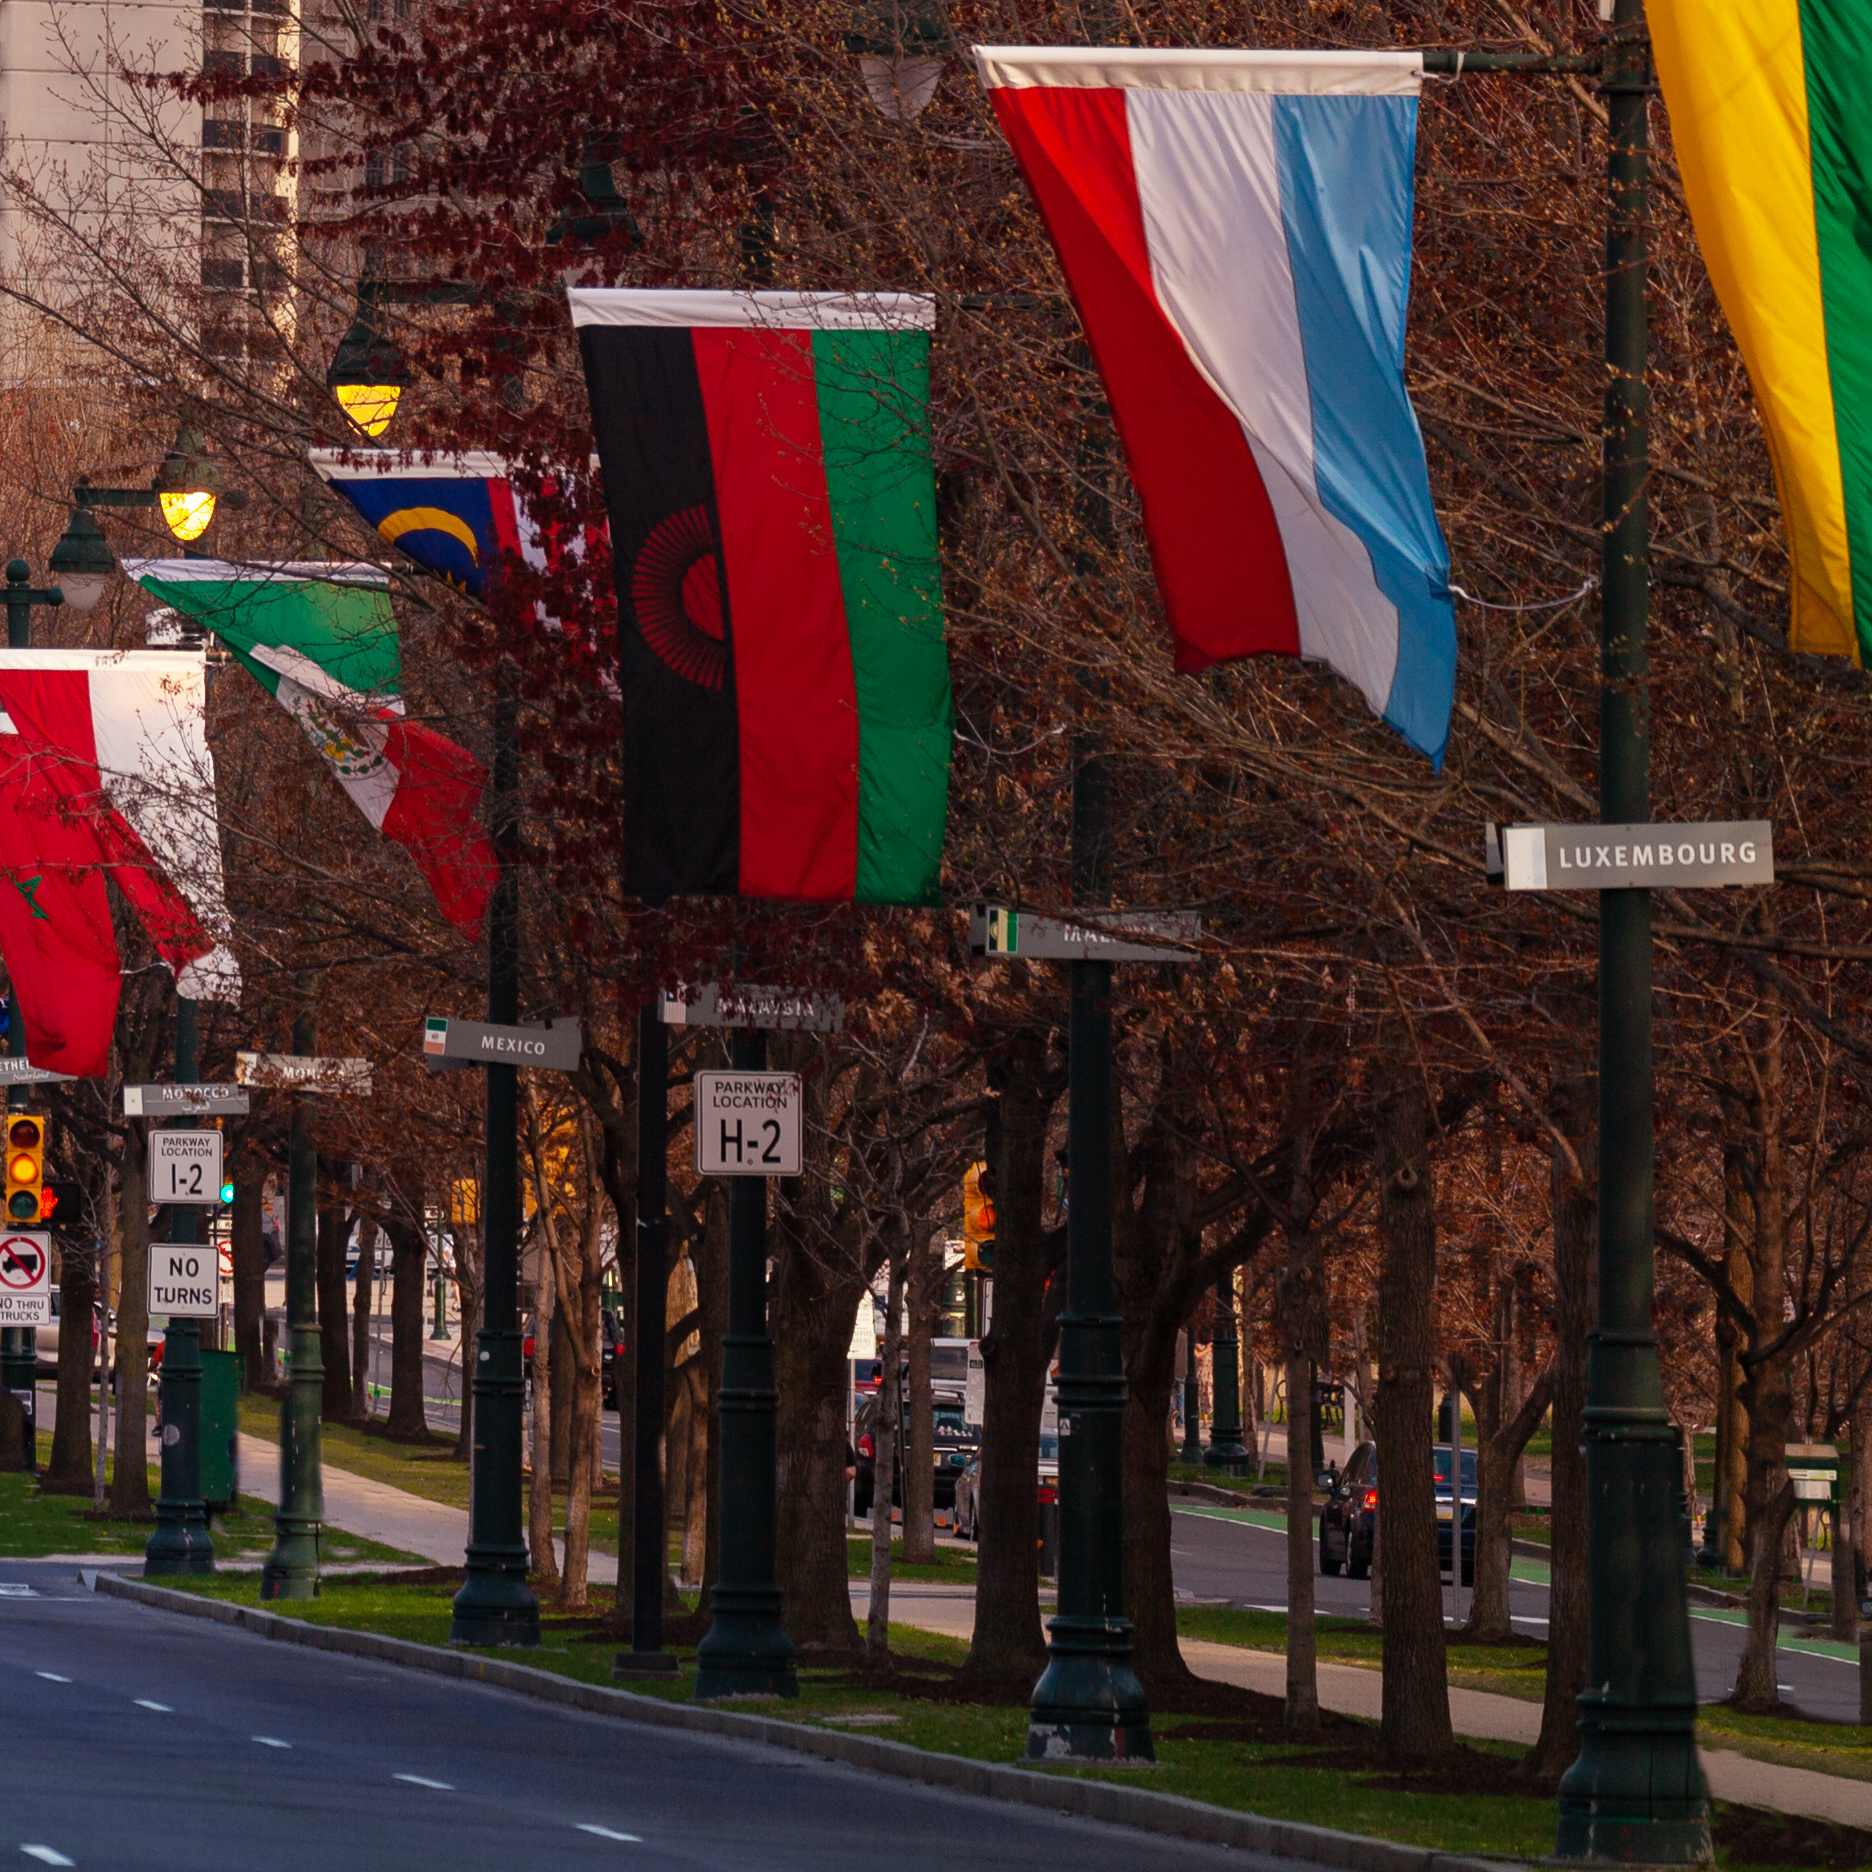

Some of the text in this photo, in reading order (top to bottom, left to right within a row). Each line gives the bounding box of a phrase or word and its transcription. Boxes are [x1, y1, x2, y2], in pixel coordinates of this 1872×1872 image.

[1559, 841, 1757, 869] LUXEMBOURG
[481, 1035, 546, 1056] MEXICO
[162, 1086, 230, 1099] MOROCCO
[714, 1081, 785, 1094] PARKWAY
[713, 1095, 788, 1109] LOCATION
[162, 1137, 211, 1147] PARKWAY
[720, 1118, 781, 1164] H-2
[161, 1147, 213, 1157] LOCATION
[170, 1163, 203, 1195] I-2
[169, 1257, 199, 1277] NO
[154, 1286, 212, 1305] TURNS
[16, 1300, 44, 1310] THRU
[0, 1311, 40, 1321] TRUCKS
